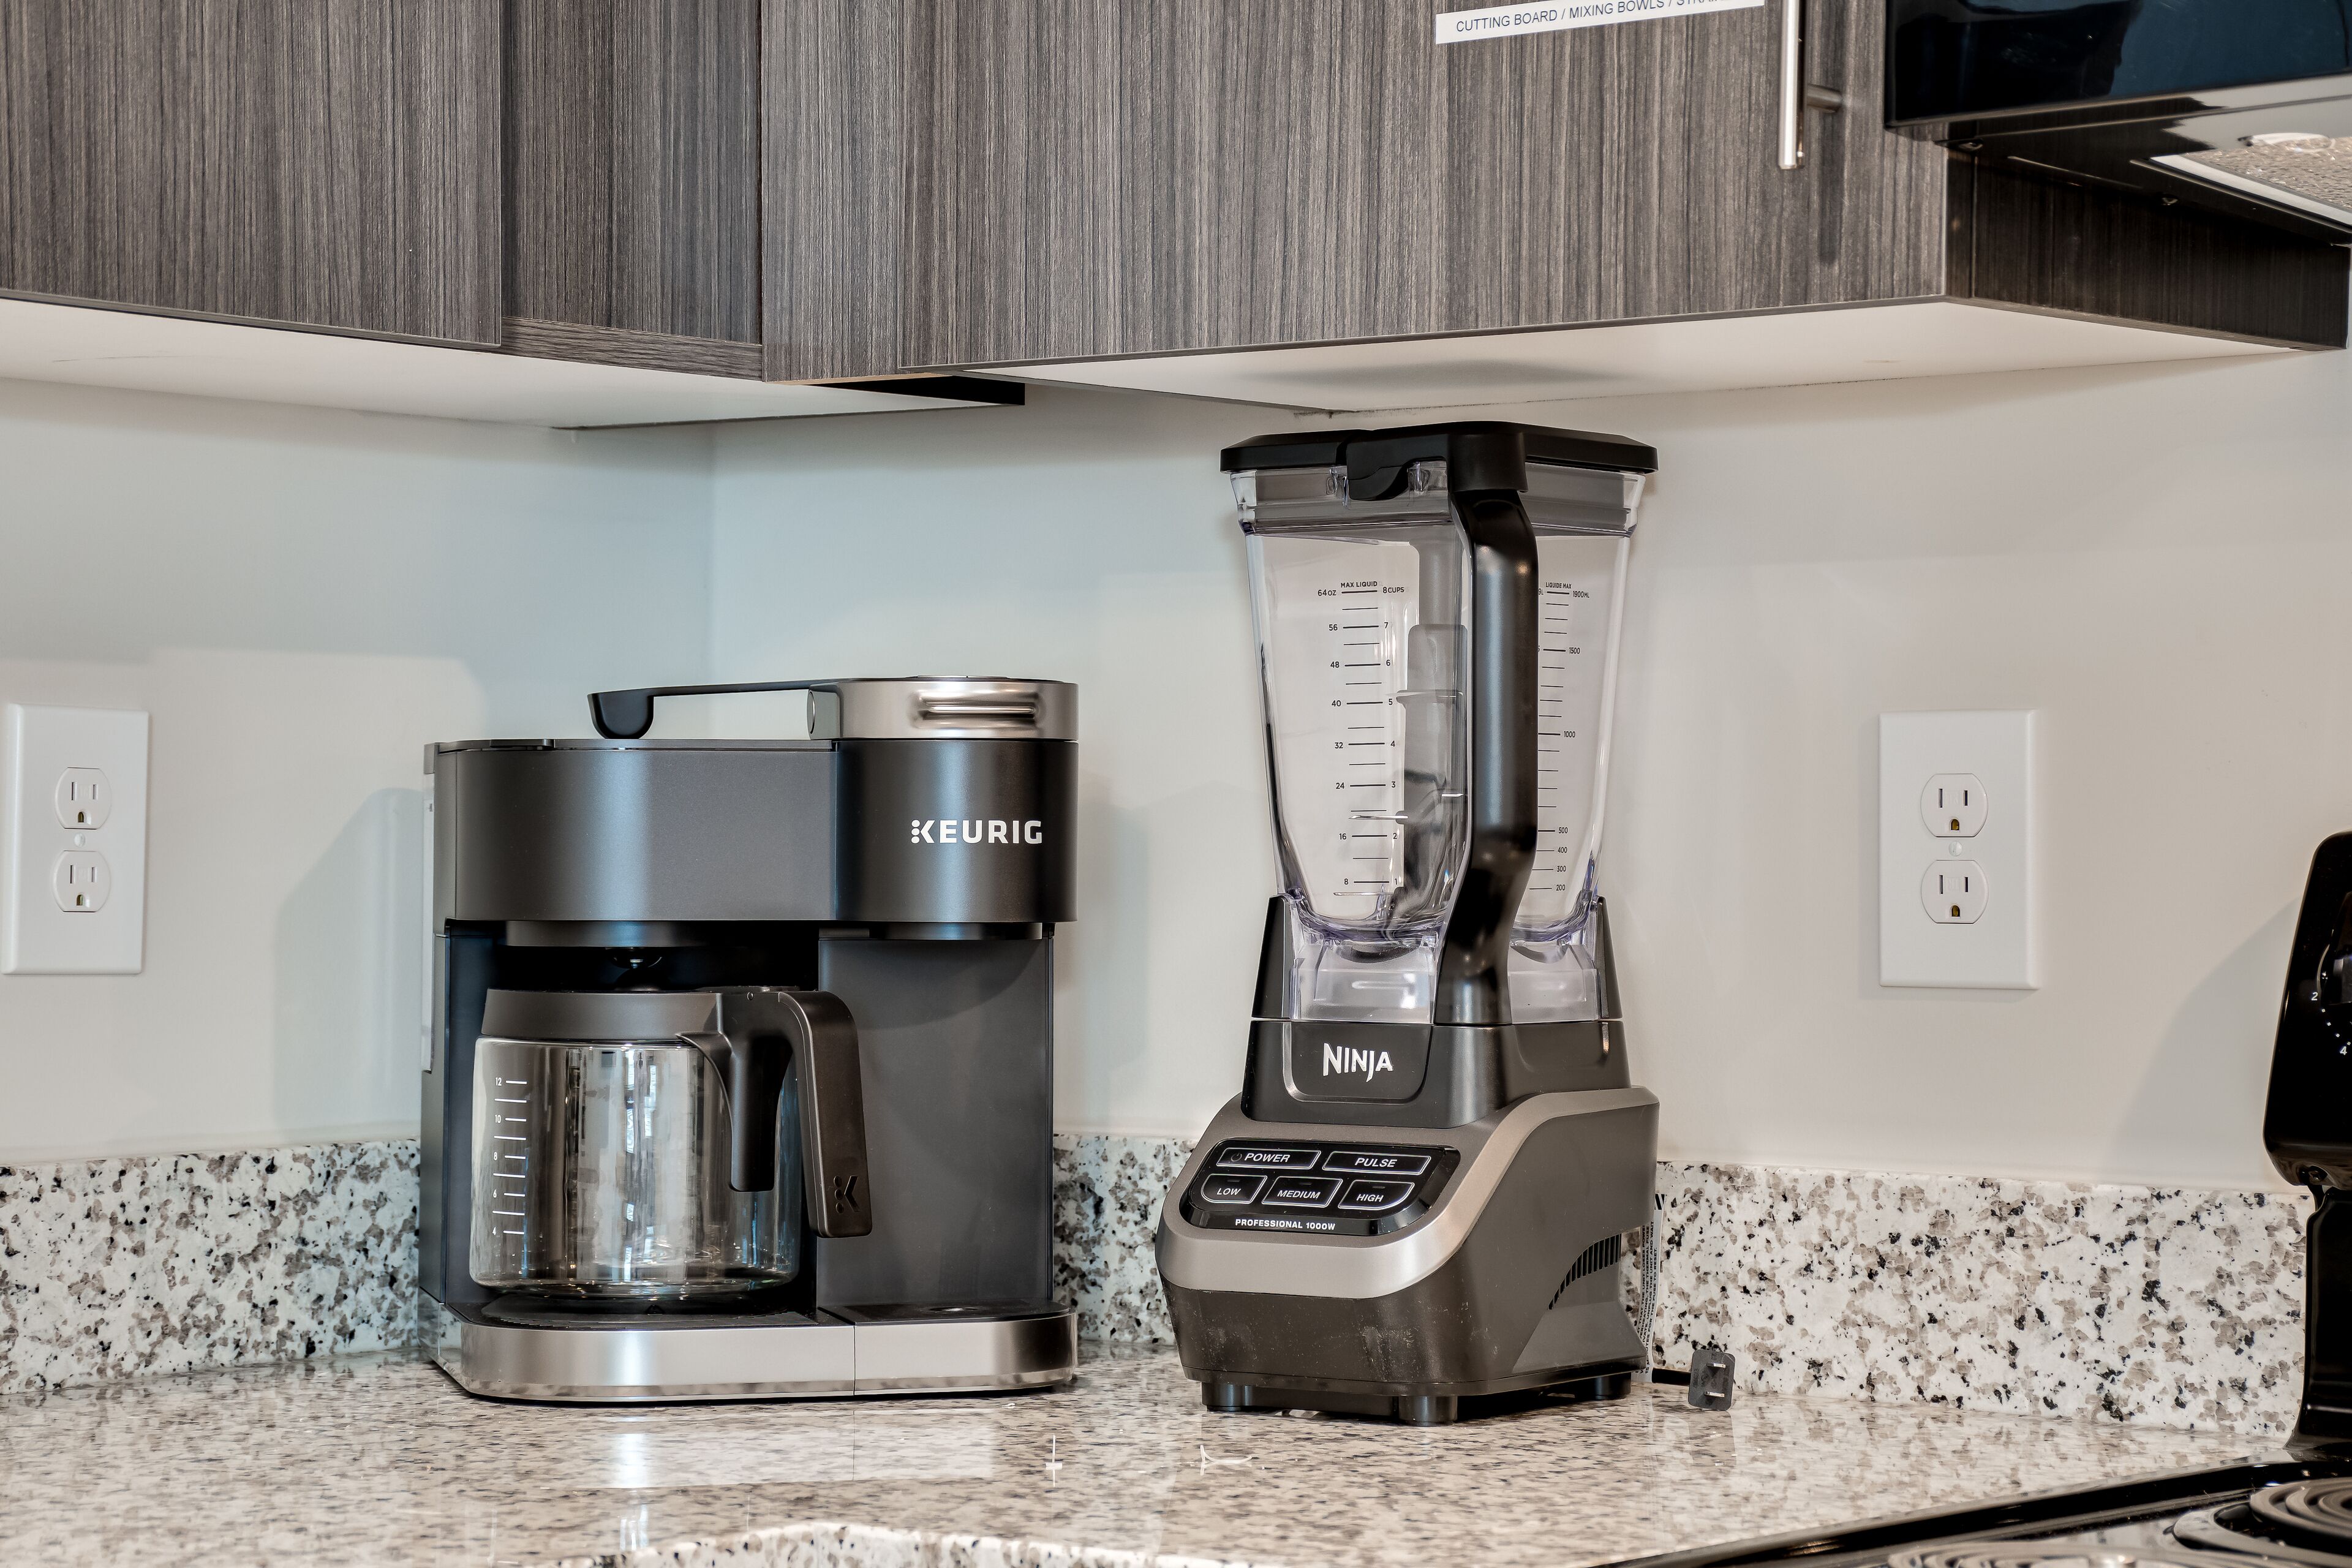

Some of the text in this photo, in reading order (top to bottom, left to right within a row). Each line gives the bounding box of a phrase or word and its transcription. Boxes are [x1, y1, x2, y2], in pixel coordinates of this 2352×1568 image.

[1457, 15, 1510, 32] CUTTING
[1514, 9, 1558, 25] BOARD
[1561, 8, 1566, 20] /
[1569, 2, 1613, 19] MIXING
[1618, 0, 1664, 13] BOWLS
[911, 820, 1042, 844] KEURIG
[2311, 992, 2318, 1001] 2
[2340, 1046, 2348, 1055] 4
[1323, 1042, 1393, 1082] NINJA
[495, 1077, 502, 1086] 12
[495, 1114, 502, 1123] 10
[493, 1152, 498, 1161] 8
[1245, 1152, 1291, 1163] POWER
[1354, 1157, 1398, 1168] PULSE
[493, 1189, 497, 1198] 6
[1216, 1187, 1242, 1196] LOW
[1277, 1189, 1321, 1200] MEDIUM
[1356, 1194, 1384, 1202] HIGH
[1235, 1219, 1336, 1231] PROFESSIONAL 1000W
[492, 1226, 497, 1235] 4
